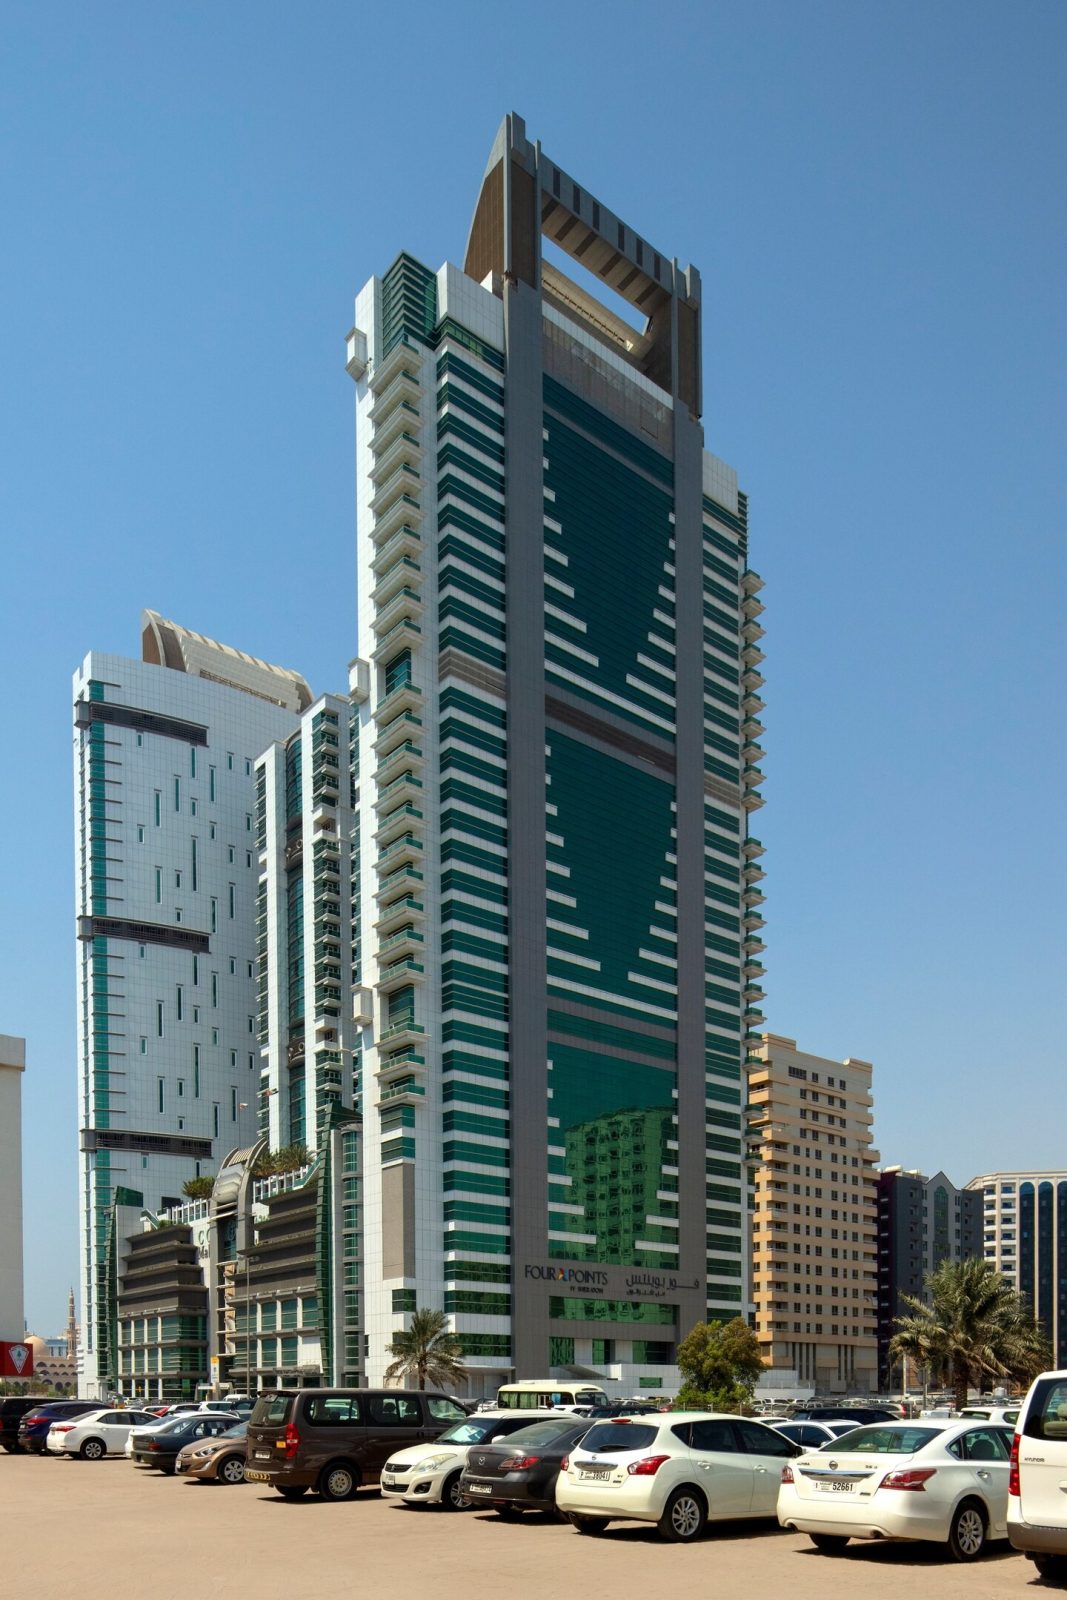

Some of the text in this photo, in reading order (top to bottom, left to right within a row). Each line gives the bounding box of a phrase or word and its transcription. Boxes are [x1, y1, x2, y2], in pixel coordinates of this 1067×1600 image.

[524, 1264, 608, 1286] FOUR POINTS
[832, 1482, 854, 1492] 52661
